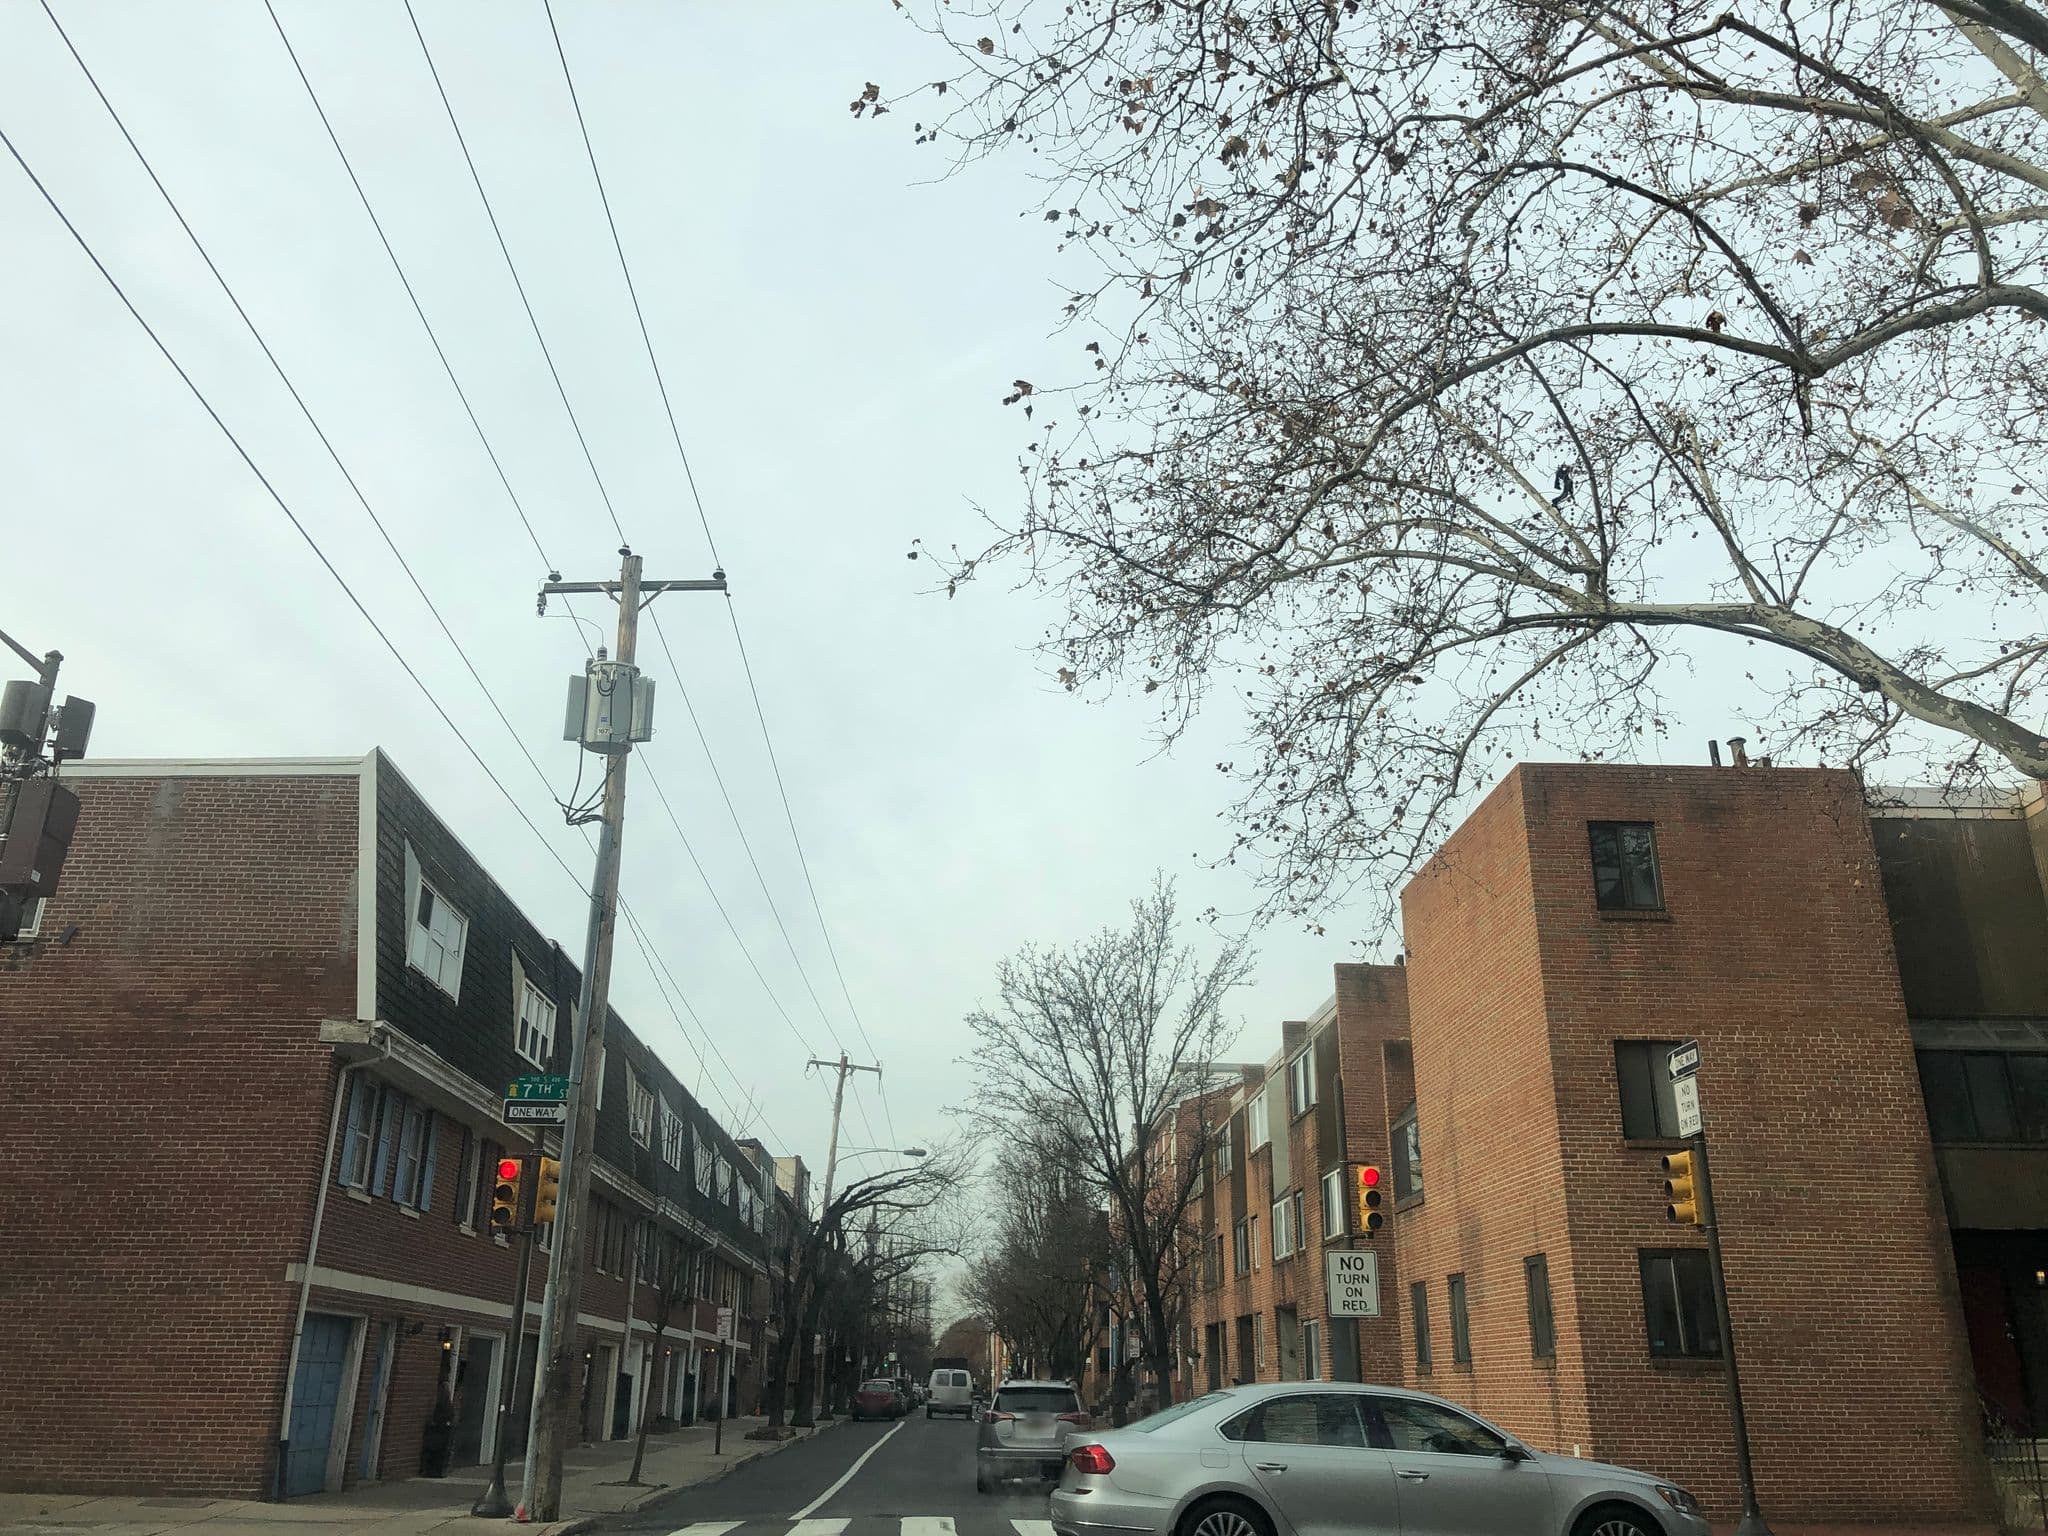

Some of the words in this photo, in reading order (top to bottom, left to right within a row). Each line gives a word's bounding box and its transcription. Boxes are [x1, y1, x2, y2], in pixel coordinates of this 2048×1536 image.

[1681, 1085, 1690, 1096] NO
[512, 1107, 532, 1117] ONE
[535, 1108, 557, 1117] WAY
[1681, 1101, 1695, 1112] TURN
[1681, 1119, 1688, 1129] ON
[1689, 1115, 1699, 1128] RED
[1340, 1257, 1364, 1271] NO
[1336, 1273, 1370, 1285] TURN
[1345, 1287, 1363, 1297] ON
[1342, 1300, 1368, 1311] RED
